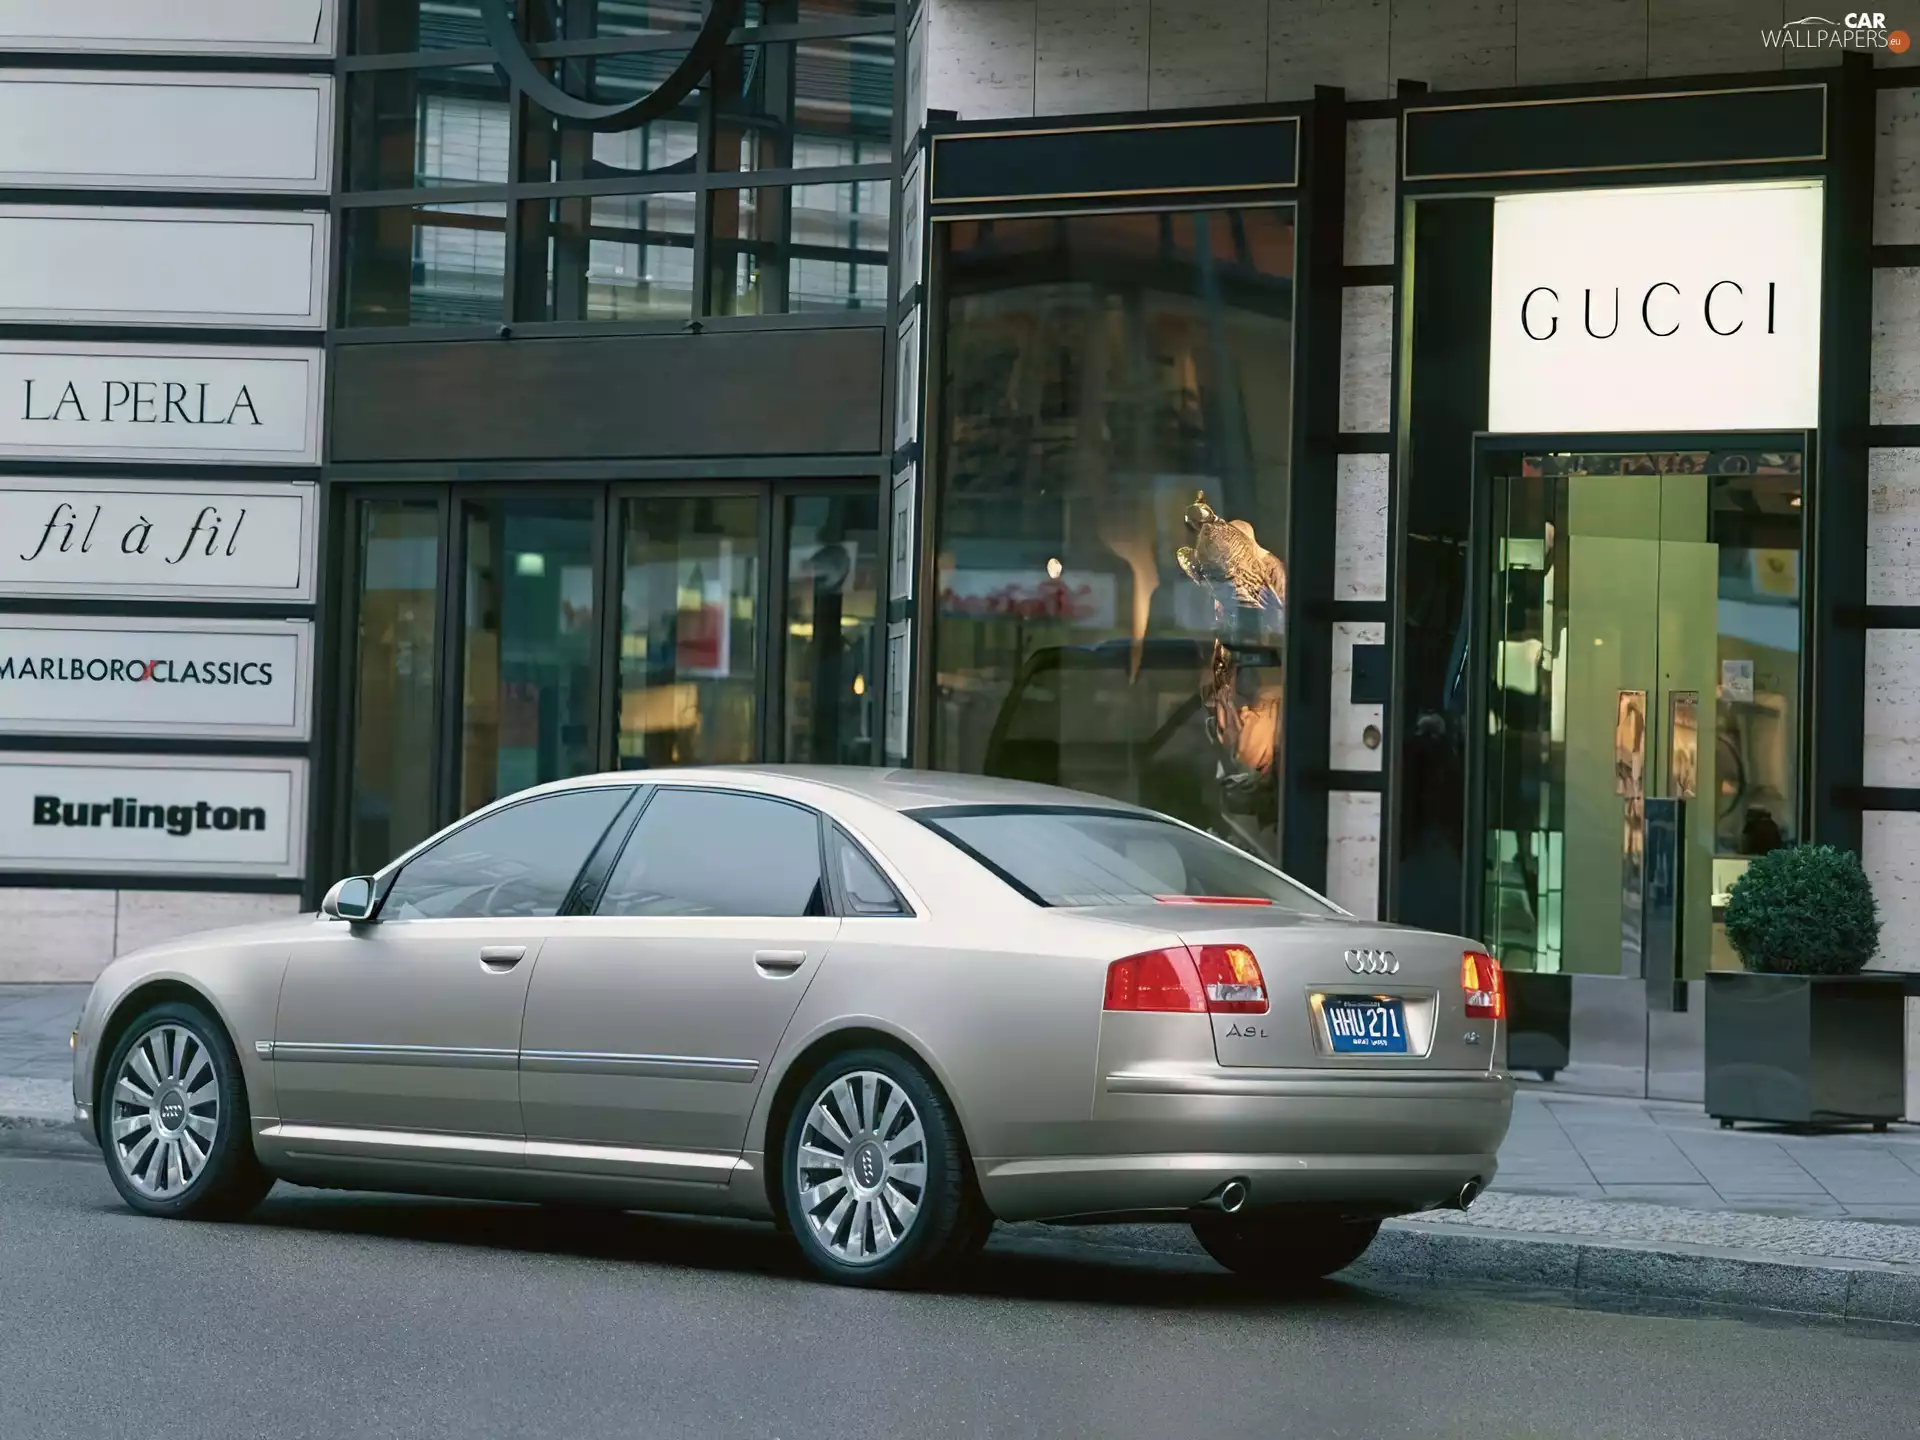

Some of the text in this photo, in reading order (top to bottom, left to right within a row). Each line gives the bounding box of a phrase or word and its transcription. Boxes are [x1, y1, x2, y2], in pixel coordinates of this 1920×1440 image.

[1520, 280, 1776, 341] GUCCI
[21, 379, 263, 425] LA PERLA
[20, 502, 246, 564] fil à fil
[33, 795, 266, 836] Burlington
[1366, 1007, 1400, 1038] 271
